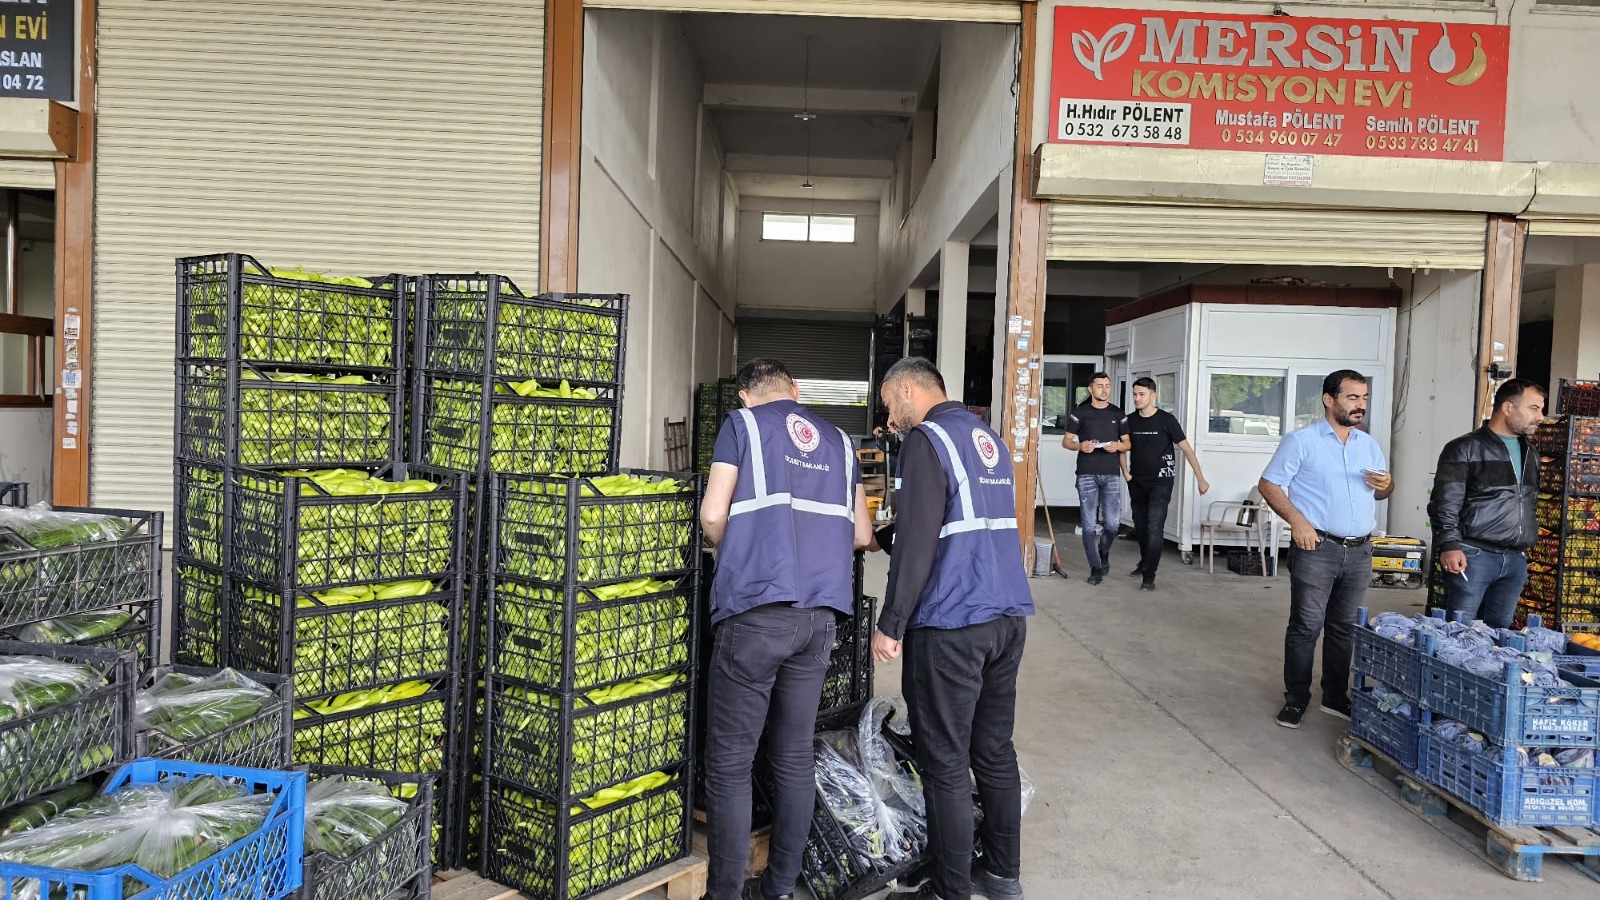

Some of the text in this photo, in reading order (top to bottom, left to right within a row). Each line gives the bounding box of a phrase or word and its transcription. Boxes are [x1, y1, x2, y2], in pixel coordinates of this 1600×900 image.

[15, 11, 47, 40] EVİ
[0, 50, 42, 68] SLAN
[2, 73, 44, 91] 04 72
[1066, 102, 1184, 122] H.Hıdır PÖLENT
[1215, 108, 1345, 130] Mustafa PÖLENT
[1065, 122, 1182, 141] 0 532 673 58 48
[1366, 114, 1480, 136] Semih PÖLENT
[1221, 128, 1343, 148] 0 534 960 07 47
[1366, 135, 1479, 153] 0 533 733 47 41
